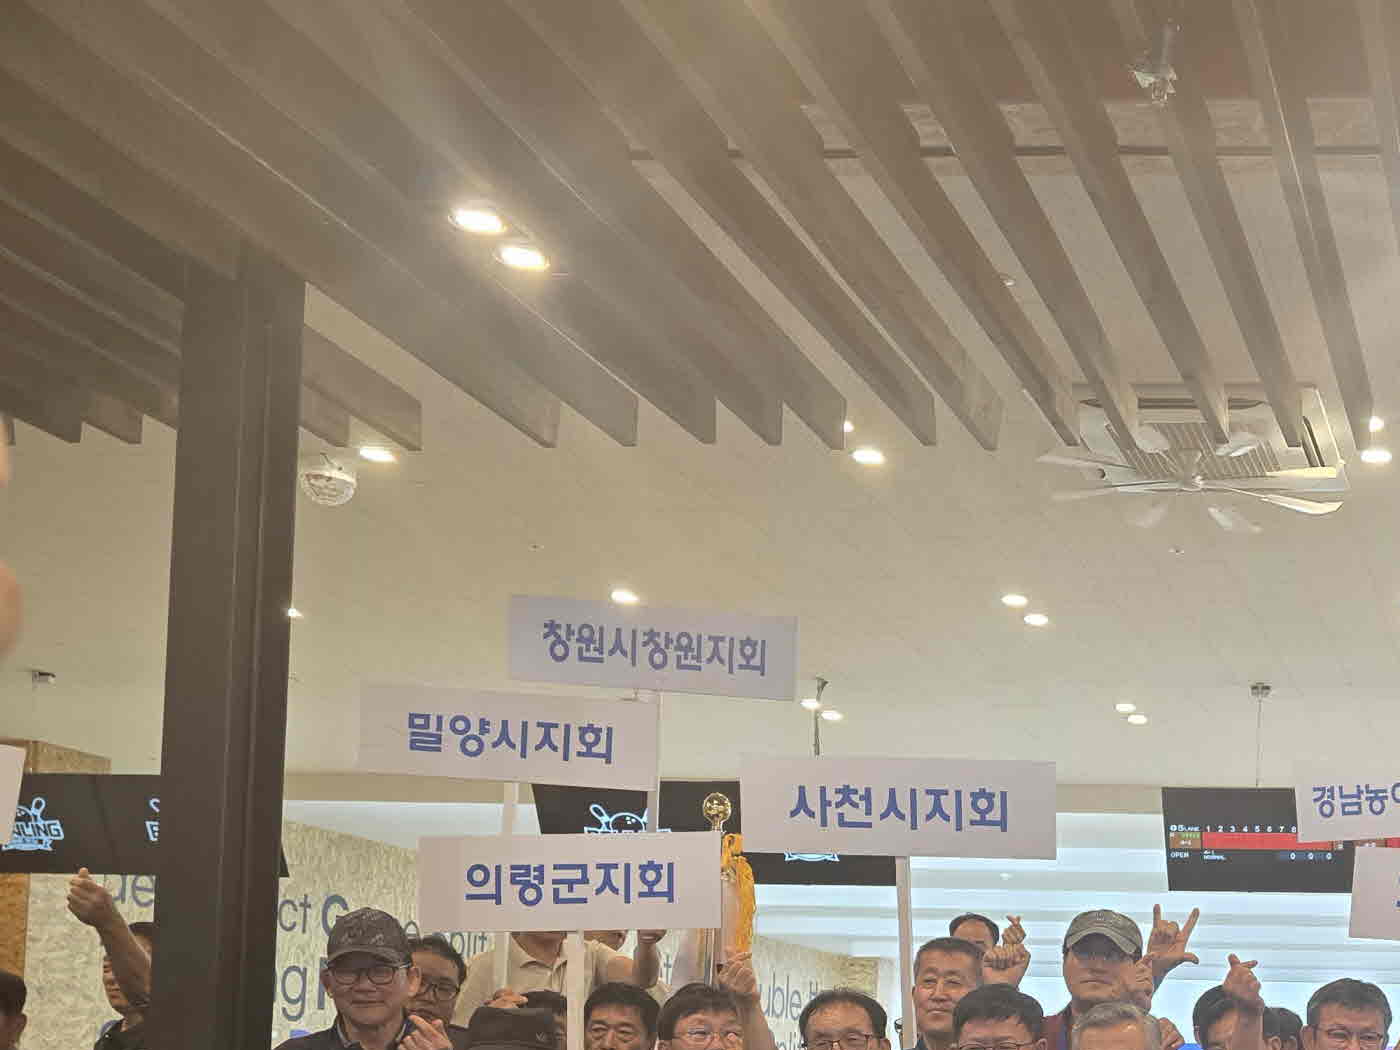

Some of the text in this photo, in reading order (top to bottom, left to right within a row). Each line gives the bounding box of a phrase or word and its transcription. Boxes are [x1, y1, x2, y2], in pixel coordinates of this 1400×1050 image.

[542, 620, 769, 675] 창원시창원지회
[406, 711, 615, 763] 밀양시지회
[788, 784, 1009, 833] 사천시지회
[464, 859, 676, 908] 의령군지회
